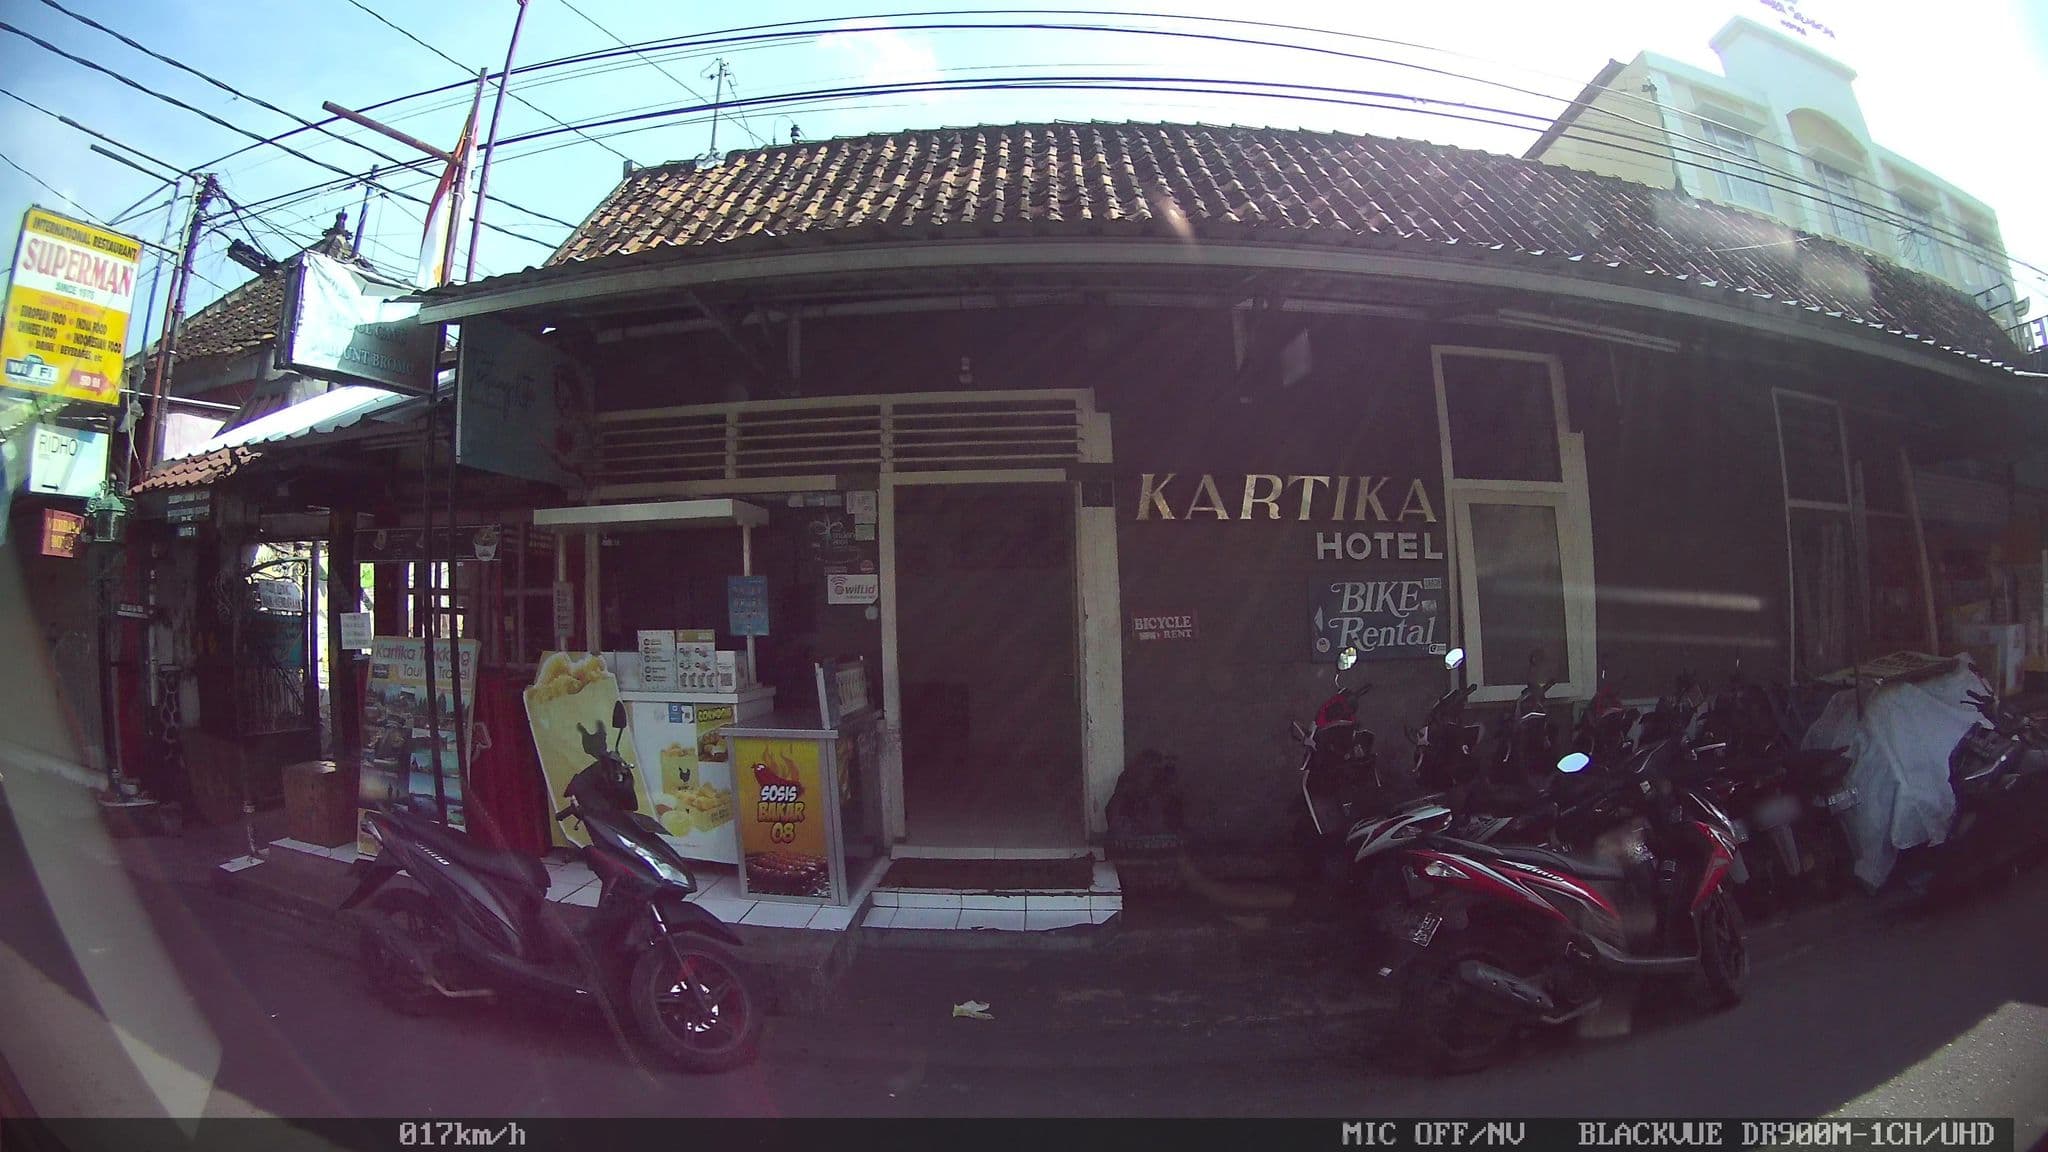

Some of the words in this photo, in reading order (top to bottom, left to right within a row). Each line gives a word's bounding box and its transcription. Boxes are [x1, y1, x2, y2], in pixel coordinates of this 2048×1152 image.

[33, 216, 91, 245] INTERNATIONAL
[92, 236, 138, 260] RESTAURANT
[22, 238, 134, 298] SUPERMAN
[55, 281, 77, 295] SINCE
[51, 311, 67, 326] FOOD
[42, 327, 58, 340] FOOD
[73, 332, 106, 351] INDONESIAN
[107, 340, 122, 354] FOOD
[39, 433, 79, 457] RIDHO
[1135, 473, 1438, 522] KARTIKA
[1315, 531, 1444, 560] HOTEL
[1330, 579, 1423, 618] BIKE
[1133, 615, 1193, 631] BICYCLE
[1163, 629, 1193, 640] RENT
[1328, 616, 1437, 652] Rental
[376, 643, 416, 662] Kartika
[760, 784, 797, 801] SOSIS
[757, 800, 805, 822] BAKAR
[769, 822, 796, 843] 08
